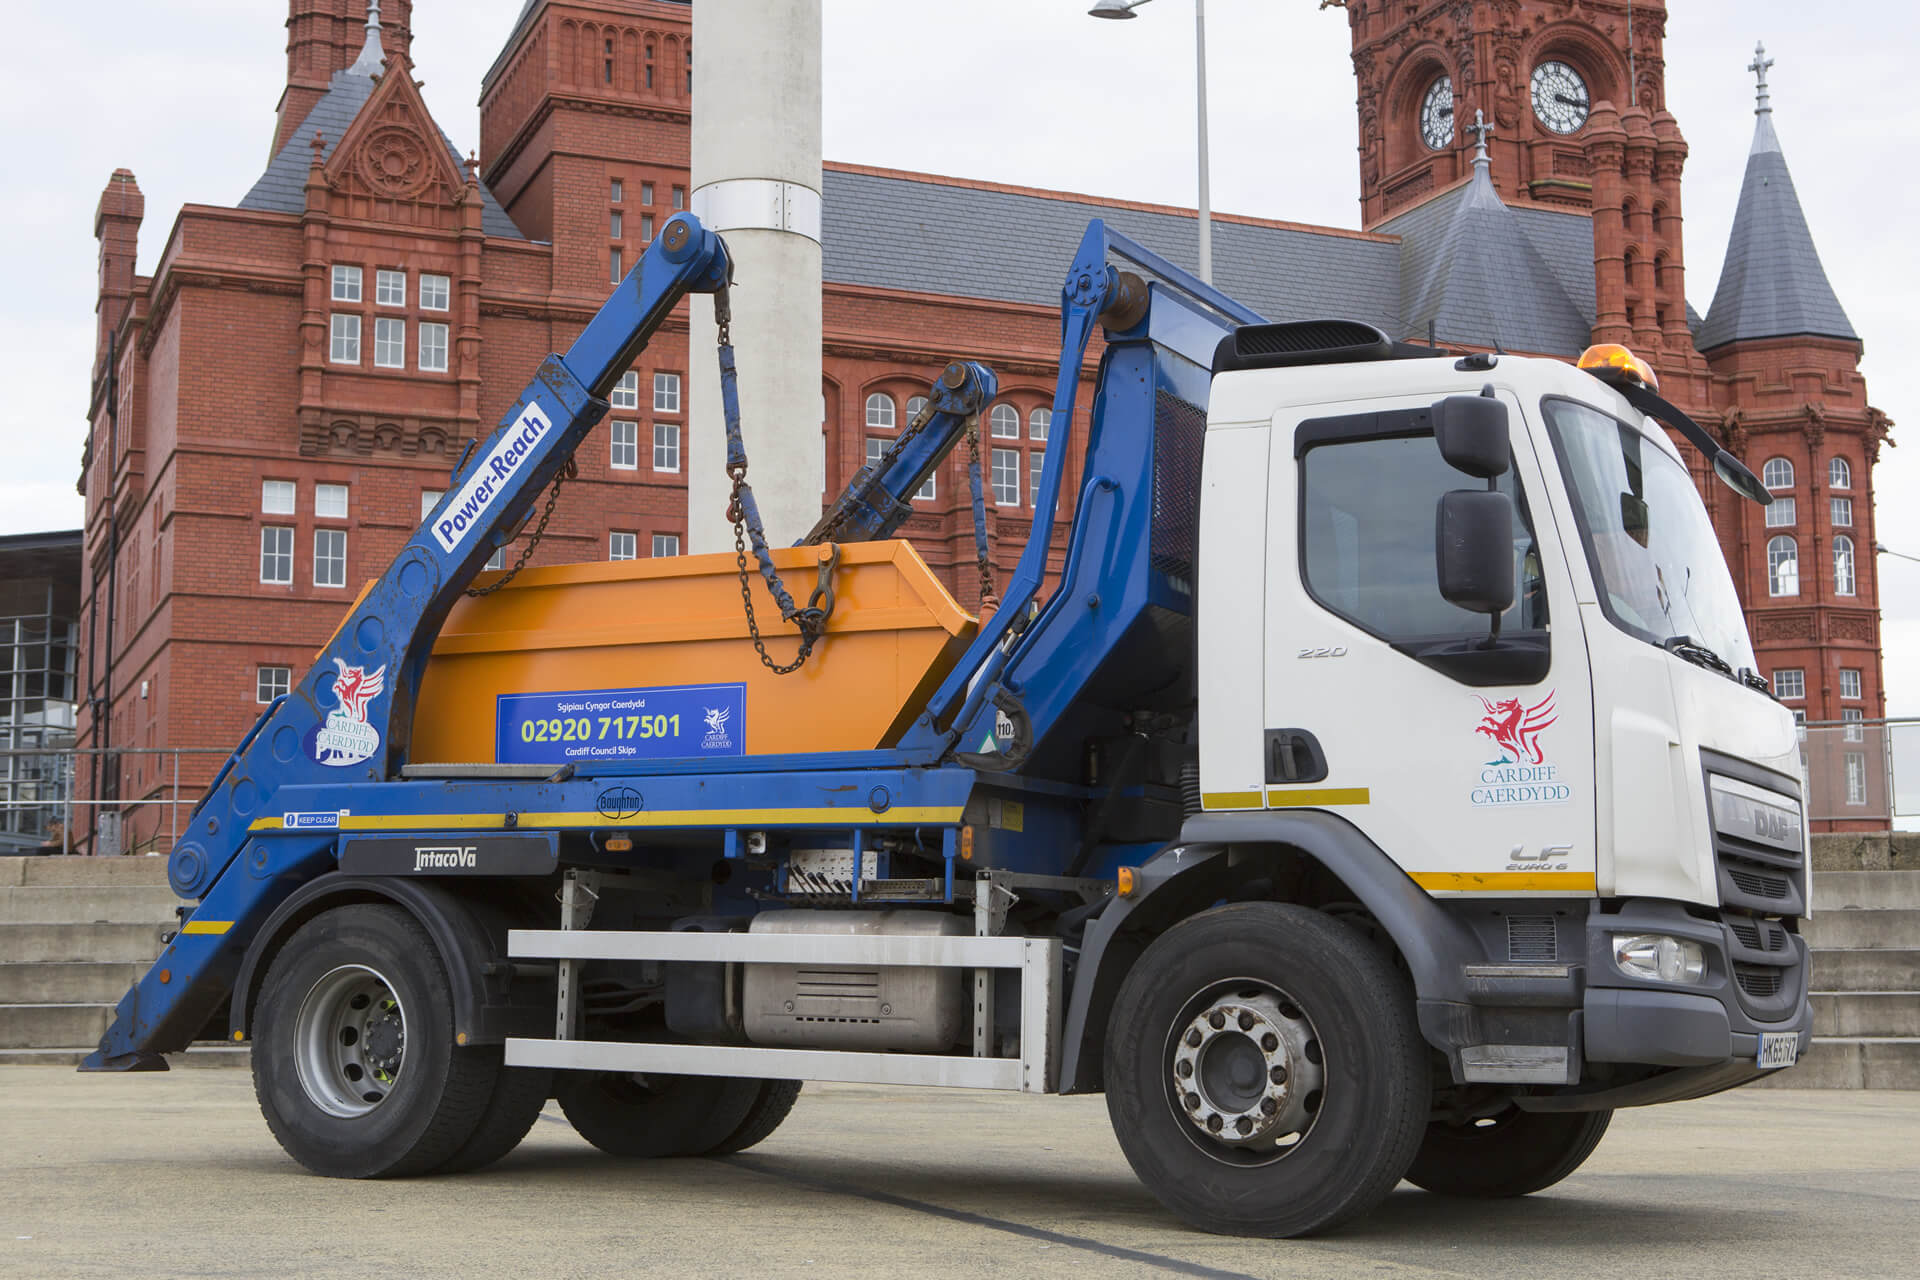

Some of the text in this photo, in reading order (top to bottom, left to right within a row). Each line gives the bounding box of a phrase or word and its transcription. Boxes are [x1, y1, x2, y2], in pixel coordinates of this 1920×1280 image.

[438, 415, 545, 545] Power-Reach
[1298, 647, 1348, 659] 220
[557, 699, 645, 713] Sgipiau Cyngor Caerdydd
[327, 719, 368, 737] CARDIFF
[521, 714, 680, 743] 02920 717501
[998, 722, 1011, 736] 110
[318, 733, 374, 752] CAERDYDD
[565, 746, 637, 757] Cardiff Council Skips
[1481, 766, 1557, 784] CARDIFF
[1471, 785, 1570, 804] CAERDYDD
[299, 816, 336, 824] KEEP CLEAR
[1754, 809, 1789, 841] DAF
[1510, 844, 1574, 861] LF
[1505, 863, 1552, 871] EURO
